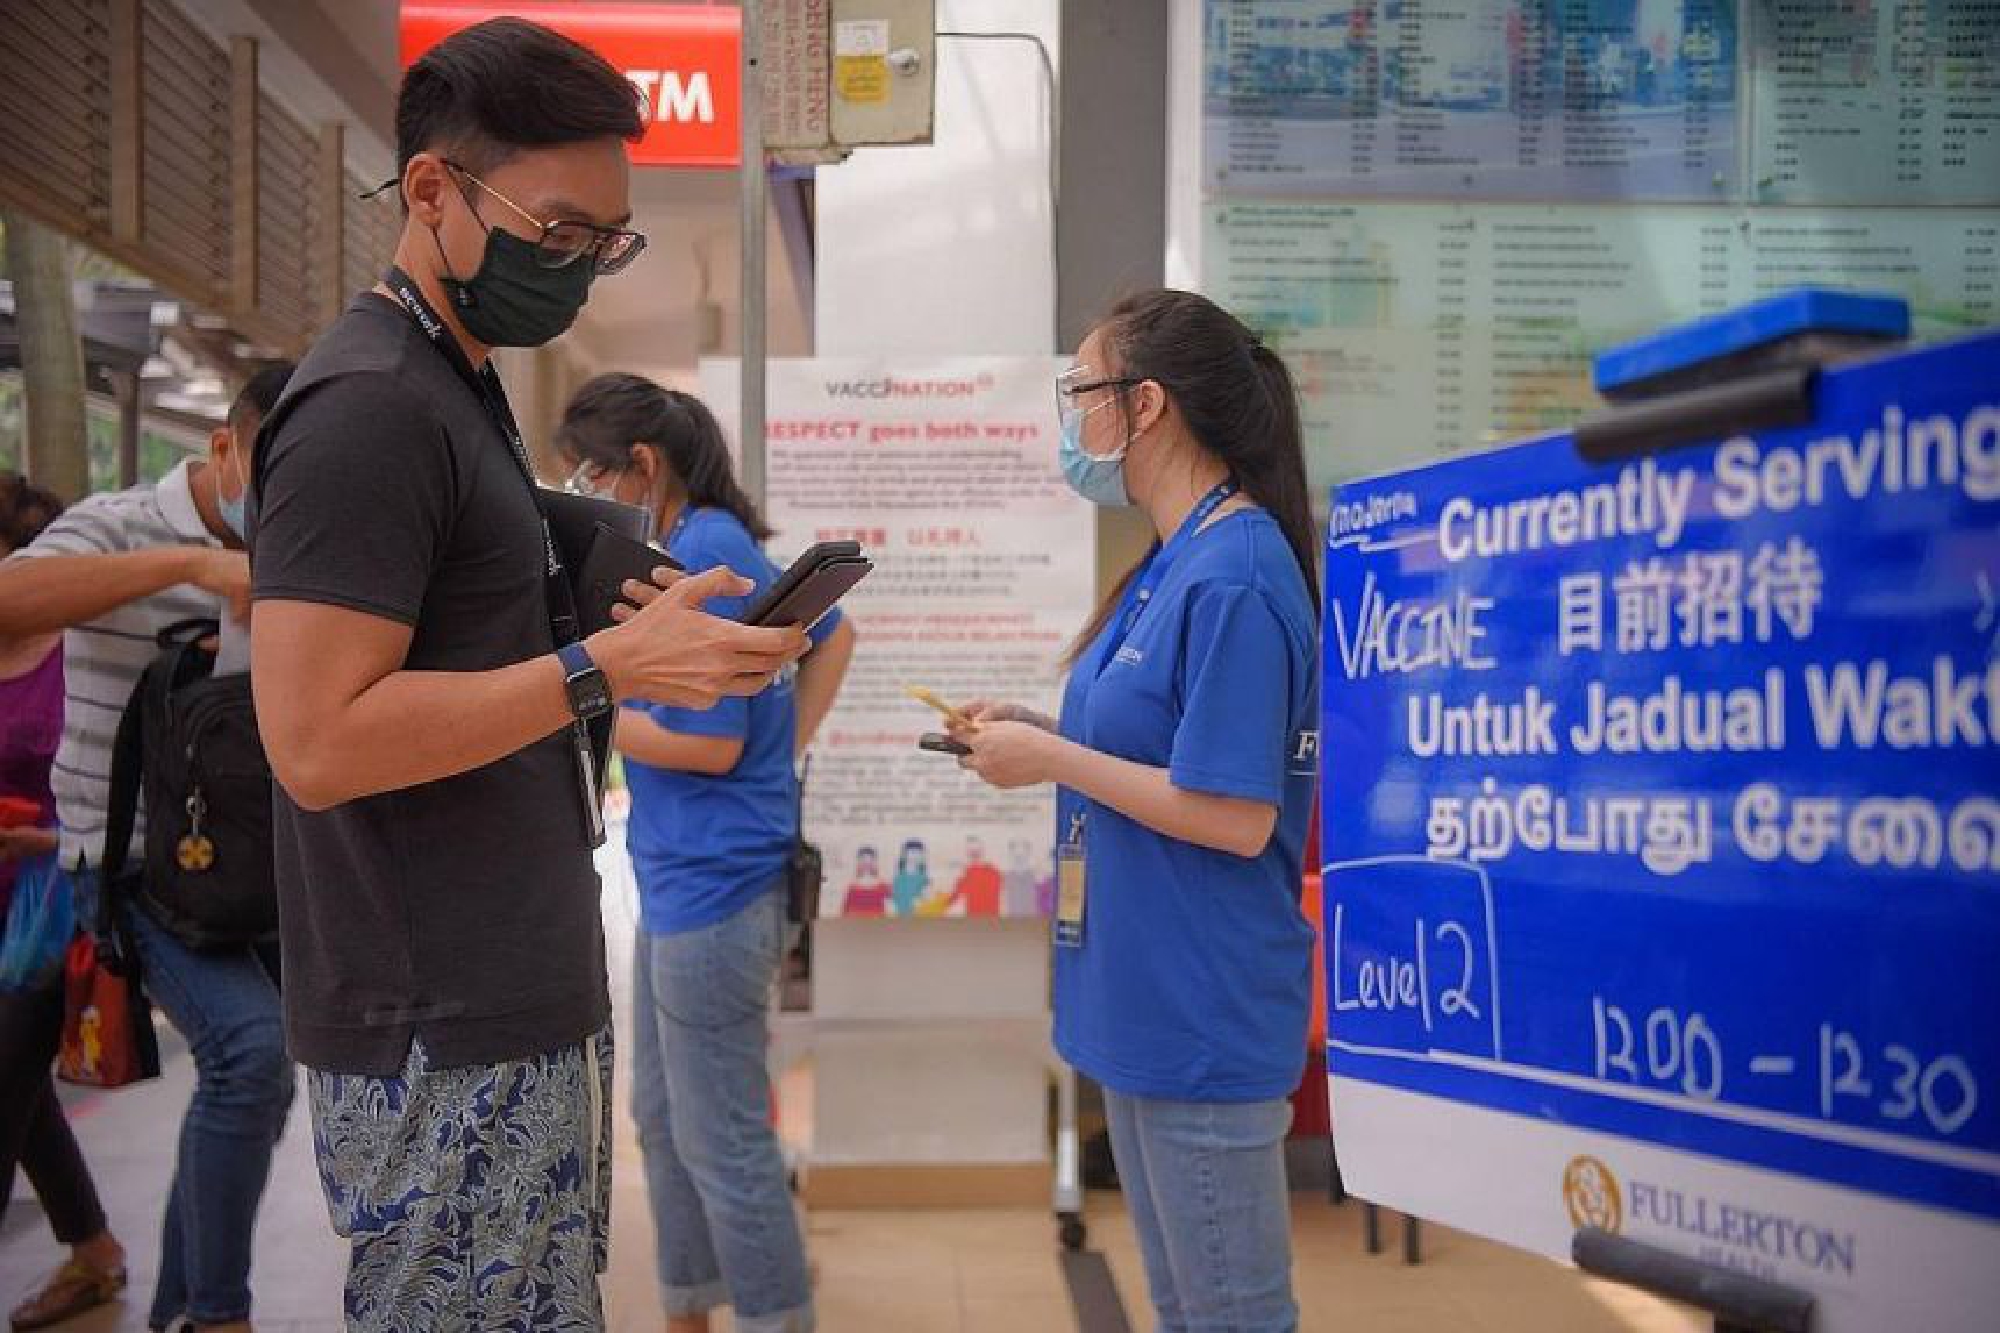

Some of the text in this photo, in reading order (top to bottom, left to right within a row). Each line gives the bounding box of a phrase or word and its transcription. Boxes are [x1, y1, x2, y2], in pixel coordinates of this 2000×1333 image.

[626, 70, 714, 123] TM
[869, 426, 918, 444] goes
[926, 420, 978, 440] both
[985, 424, 1038, 444] ways
[1438, 404, 2000, 562] Currently Serving
[1332, 570, 1498, 680] VACCINE
[1557, 537, 1824, 657] 目前招待
[1407, 684, 1557, 757] Untuk
[1570, 666, 1787, 756] Jadual
[1334, 904, 1480, 1032] Level 2
[1629, 1180, 1856, 1274] FULLERTON
